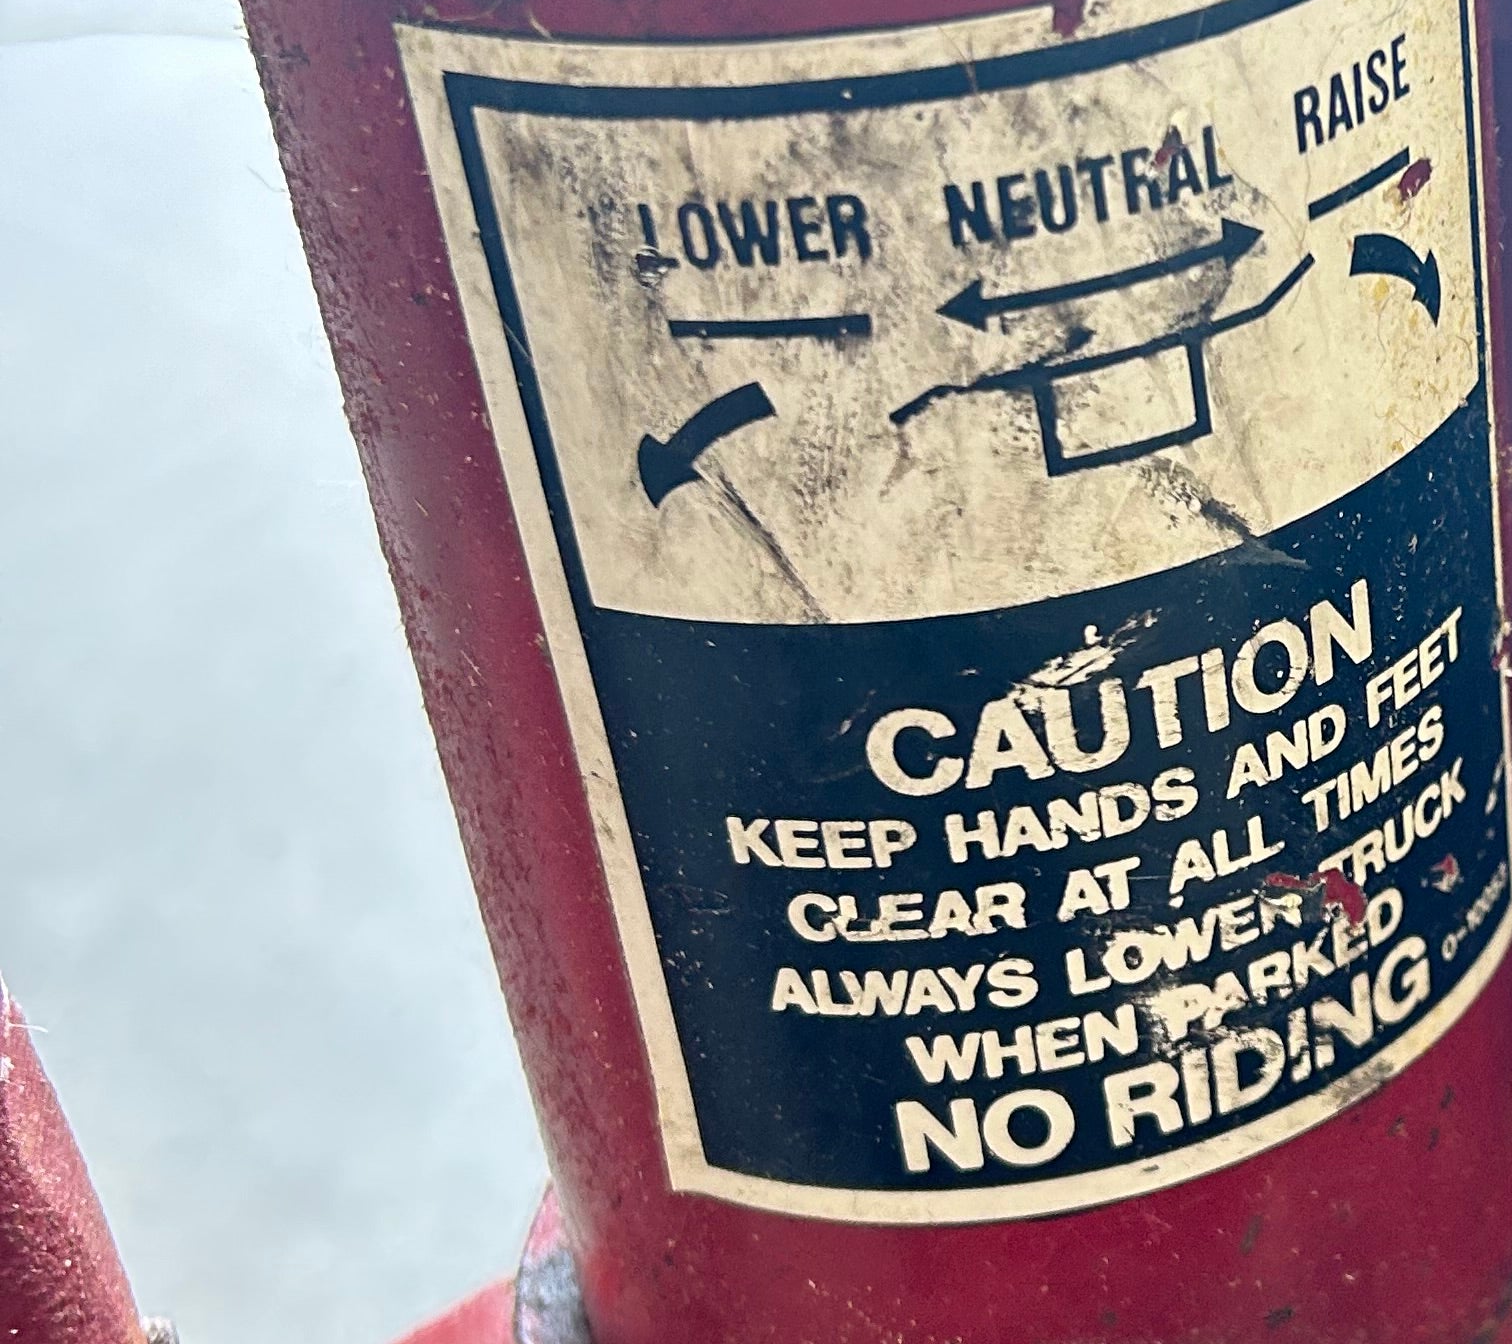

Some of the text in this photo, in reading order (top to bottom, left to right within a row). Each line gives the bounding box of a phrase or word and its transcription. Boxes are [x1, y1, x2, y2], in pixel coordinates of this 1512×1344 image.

[637, 125, 1232, 273] LOWER NEUTRAL
[1293, 33, 1412, 155] RAISE
[725, 606, 1464, 870] KEEP HANDS AND FEET
[866, 578, 1374, 798] CAUTION
[771, 957, 1040, 1017] ALWAYS
[1317, 757, 1468, 888] TRUCK
[786, 704, 1446, 943] CLEAR AT ALL TIMES
[894, 934, 1432, 1173] NO RIDING
[904, 1003, 1138, 1085] WHEN
[1145, 887, 1404, 1043] PARKED
